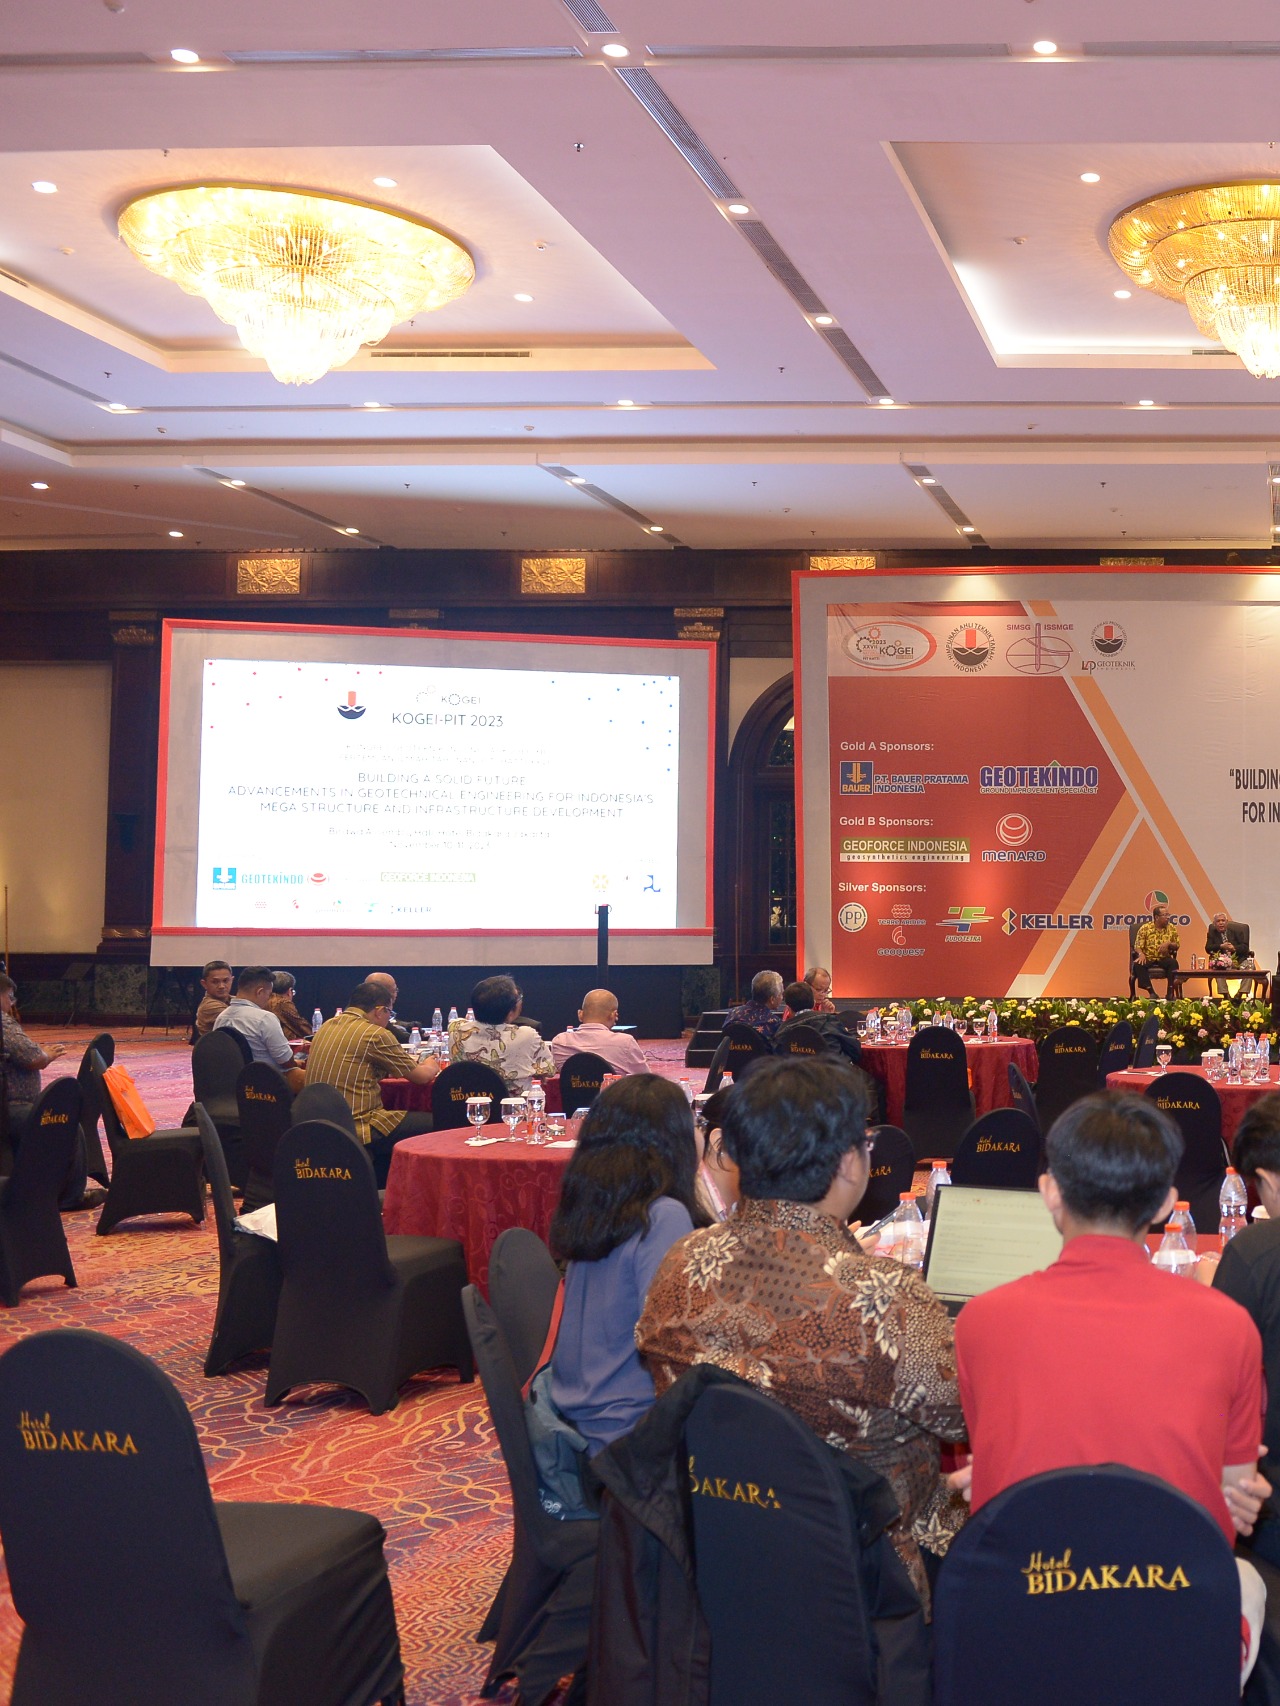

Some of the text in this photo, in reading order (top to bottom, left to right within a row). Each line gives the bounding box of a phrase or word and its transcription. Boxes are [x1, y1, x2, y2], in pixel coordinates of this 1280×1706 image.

[879, 645, 914, 656] KOGEI
[953, 663, 987, 673] INDONESIA
[391, 712, 504, 728] KOGEI-PIT 2023
[840, 742, 935, 753] Gold A Sponsors:
[358, 772, 419, 784] BUILDING
[891, 775, 922, 784] BAUER
[924, 775, 969, 784] PRATAMA
[980, 765, 1098, 787] GEOTEKINDO
[228, 785, 336, 798] ADVANCEMENTS
[358, 787, 454, 800] GEOTECHNICAL
[842, 784, 871, 793] BAUER
[874, 784, 925, 793] INDONESIA
[260, 802, 297, 812] MEGA
[301, 803, 379, 814] STRUCTURE
[533, 806, 624, 818] DEVELOPMENT
[1242, 802, 1265, 824] FOR
[839, 817, 934, 828] Gold B Sponsors:
[843, 841, 968, 851] GEOFORCE INDONESIA
[838, 882, 927, 894] Silver Sponsors:
[845, 911, 862, 925] PP
[1021, 914, 1094, 930] KELLER
[1103, 914, 1191, 930] promco
[945, 935, 982, 943] FUDOTETRA
[920, 1052, 954, 1060] BIDAKARA
[571, 1080, 602, 1089] BIDAKAR
[245, 1091, 277, 1102] BIDAKARA
[976, 1142, 1020, 1153] BIDAKARA
[296, 1167, 351, 1180] BIDAKARA
[16, 1410, 51, 1431] Hotel
[21, 1429, 139, 1455] BIDAKARA
[688, 1474, 781, 1509] DAKARA
[1020, 1547, 1072, 1573] Hotel
[1026, 1563, 1190, 1595] BIDAKARA
